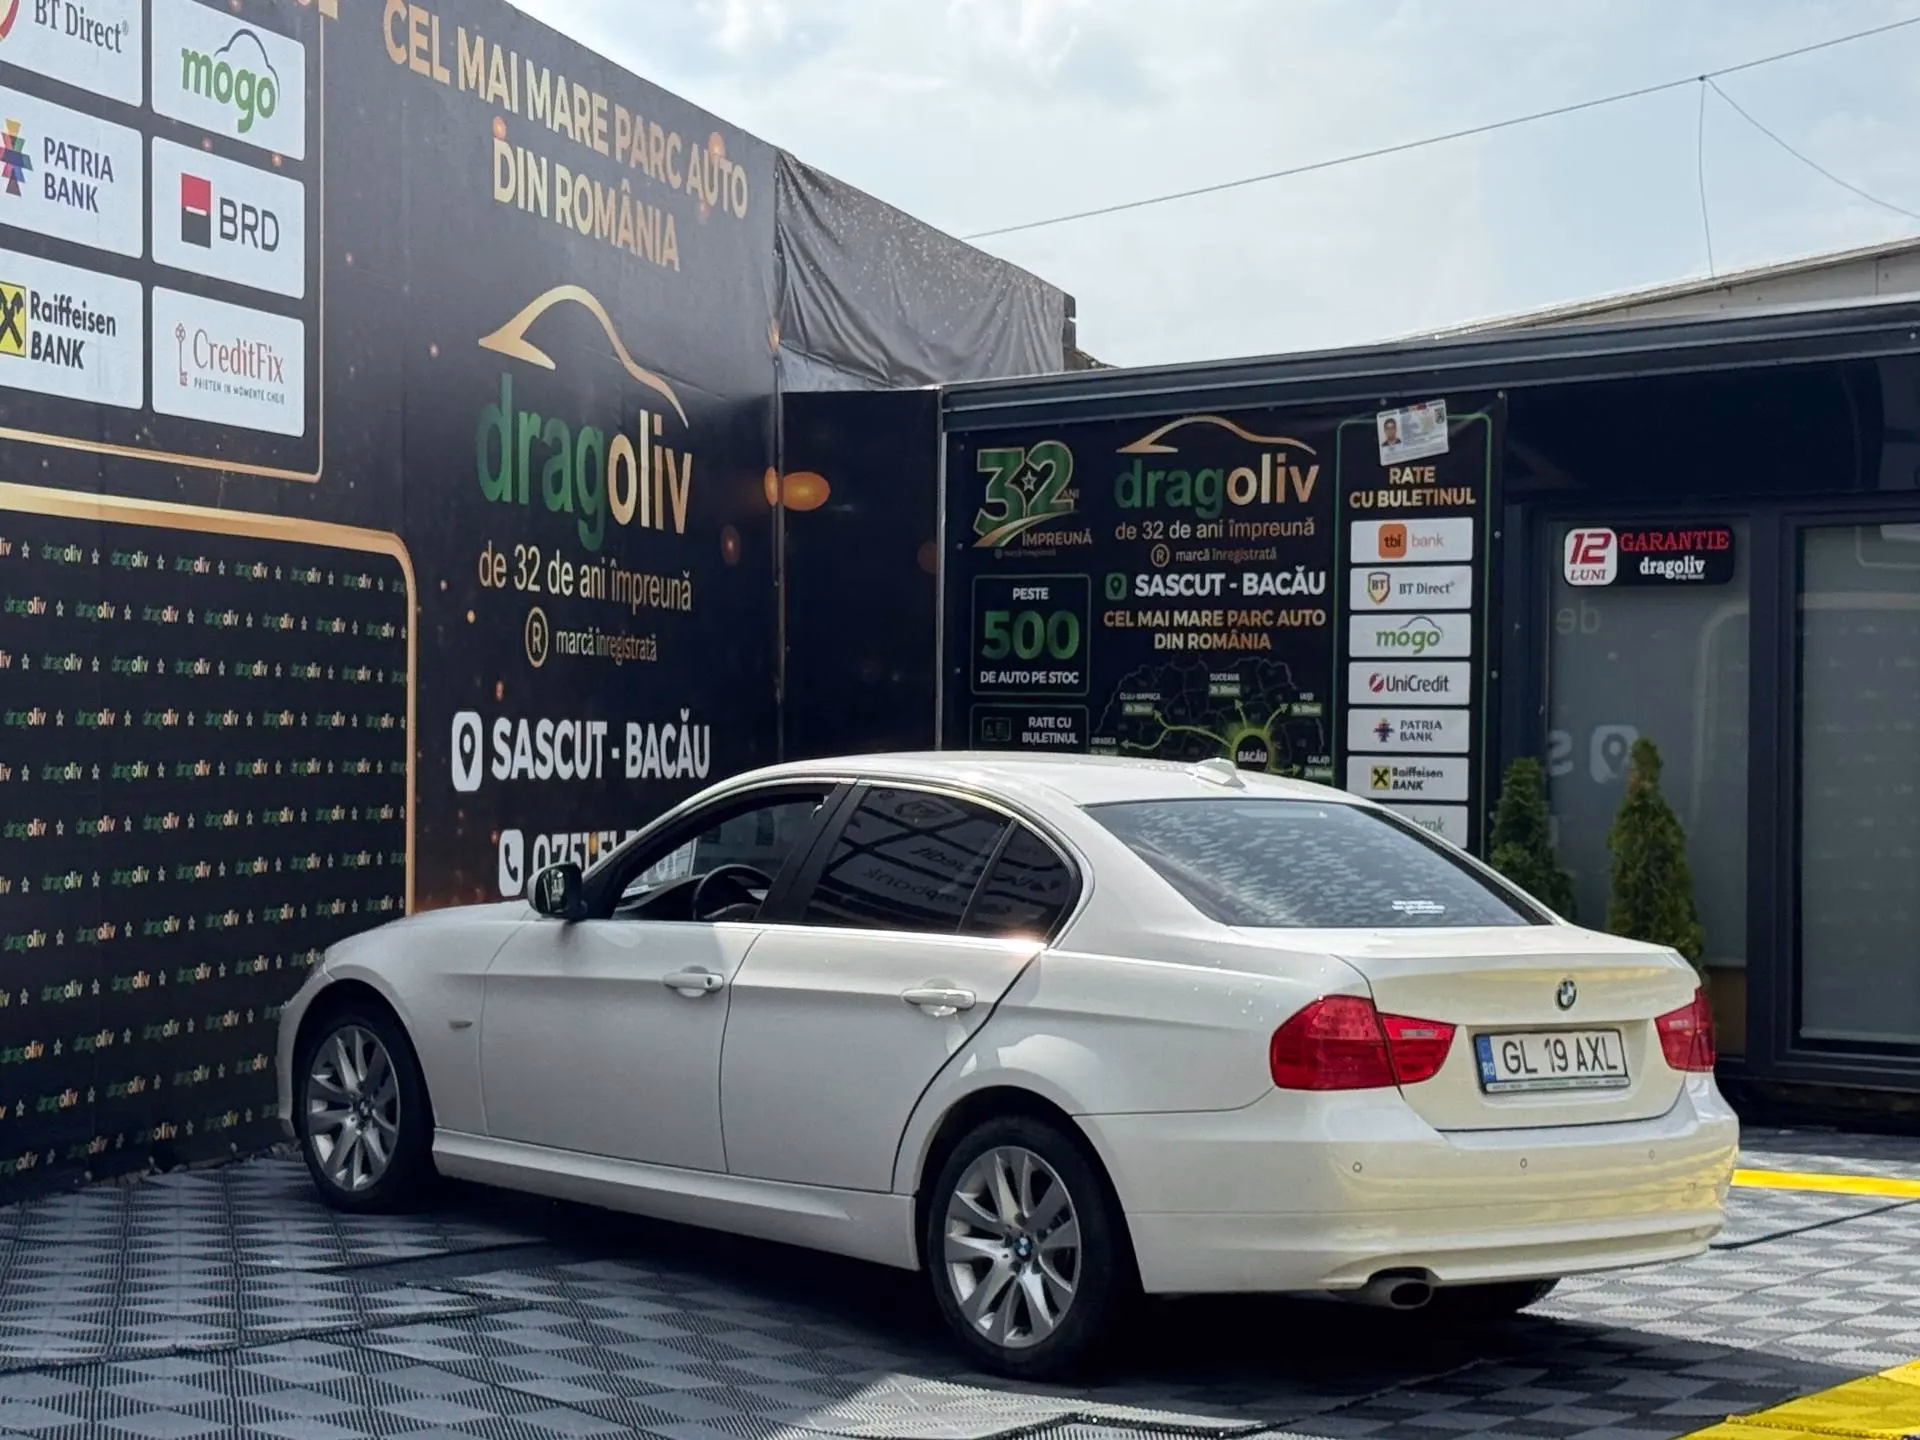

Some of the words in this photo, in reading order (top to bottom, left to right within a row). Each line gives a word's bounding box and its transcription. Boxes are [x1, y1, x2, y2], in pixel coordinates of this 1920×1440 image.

[34, 0, 60, 30] BT
[181, 48, 276, 133] mogo
[383, 0, 450, 85] CEL
[457, 26, 519, 114] MAI
[526, 59, 609, 157] MARE
[614, 106, 682, 190] PARC
[686, 142, 748, 219] AUTO
[44, 137, 114, 183] PATRIA
[44, 173, 99, 213] BANK
[493, 138, 548, 218] DIN
[555, 165, 680, 271] ROMÂNIA
[220, 197, 280, 252] BRD
[30, 291, 117, 337] Raiffeisen
[31, 330, 84, 370] BANK
[193, 329, 284, 385] CreditFix
[477, 372, 692, 551] dragoliv
[1389, 466, 1436, 484] RATE
[973, 440, 1075, 538] 32
[1114, 453, 1320, 519] dragoliv
[1350, 492, 1372, 508] CU
[1377, 487, 1476, 507] BULETINUL
[1115, 522, 1134, 540] de
[1142, 521, 1164, 540] 32
[1169, 520, 1191, 540] de
[1197, 520, 1223, 539] ani
[1228, 517, 1315, 545] împreună
[1384, 534, 1402, 548] tbi
[1412, 533, 1444, 548] bank
[1569, 533, 1612, 565] 12
[1620, 531, 1729, 551] GARANTIE
[478, 540, 506, 588] de
[514, 545, 541, 592] 32
[548, 550, 573, 597] de
[580, 557, 606, 600] ani
[610, 559, 692, 615] împreună
[1135, 573, 1226, 598] SASCUT
[1242, 566, 1326, 597] BACĂU
[1570, 569, 1606, 581] LUNI
[1639, 555, 1705, 579] dragoliv
[1012, 588, 1049, 600] PESTE
[1399, 583, 1414, 595] BT
[1104, 611, 1136, 628] CEL
[1140, 611, 1169, 627] MAI
[1173, 610, 1223, 627] MARE
[1227, 609, 1274, 627] PARC
[1277, 609, 1326, 627] AUTO
[556, 626, 595, 656] marcă
[981, 610, 1080, 661] 500
[1154, 634, 1185, 650] DIN
[1187, 629, 1272, 650] ROMÂNIA
[1375, 630, 1441, 655] mogo
[980, 672, 997, 684] DE
[998, 672, 1030, 684] AUTO
[1031, 671, 1047, 684] PE
[1048, 671, 1079, 684] STOC
[1386, 675, 1449, 692] UniCredit
[1028, 717, 1054, 729] RATE
[1055, 717, 1072, 729] CU
[1400, 720, 1443, 731] PATRIA
[1400, 732, 1433, 742] BANK
[491, 717, 608, 780] SASCUT
[625, 708, 710, 779] BACĂU
[1022, 732, 1078, 745] BULETINUL
[1392, 780, 1424, 791] BANK
[1482, 1061, 1496, 1076] RO
[1502, 1040, 1538, 1074] GL
[1544, 1038, 1569, 1072] 19
[1576, 1036, 1618, 1072] AXL
